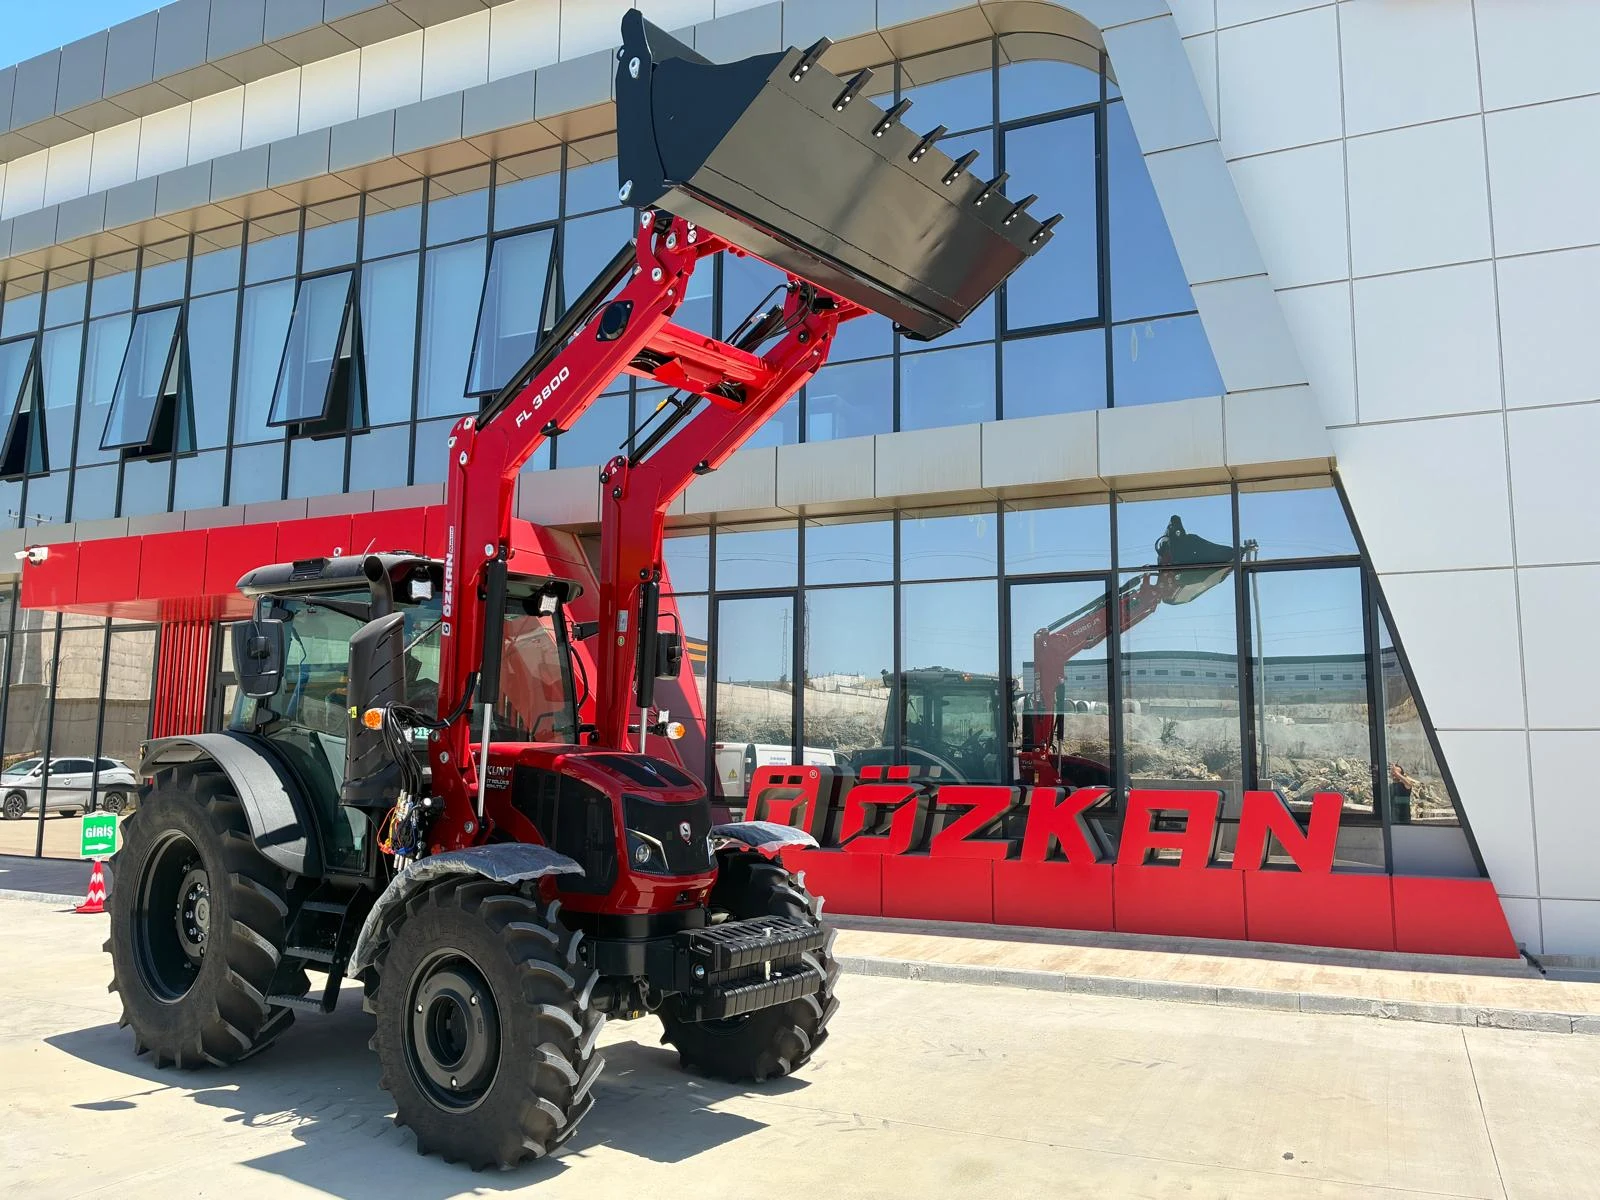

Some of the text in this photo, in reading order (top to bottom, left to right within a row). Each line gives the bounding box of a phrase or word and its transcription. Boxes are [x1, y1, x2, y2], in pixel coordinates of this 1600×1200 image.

[515, 366, 570, 428] FL 3800
[85, 824, 114, 840] GİRİŞ
[840, 764, 1344, 873] ÖZKAN
